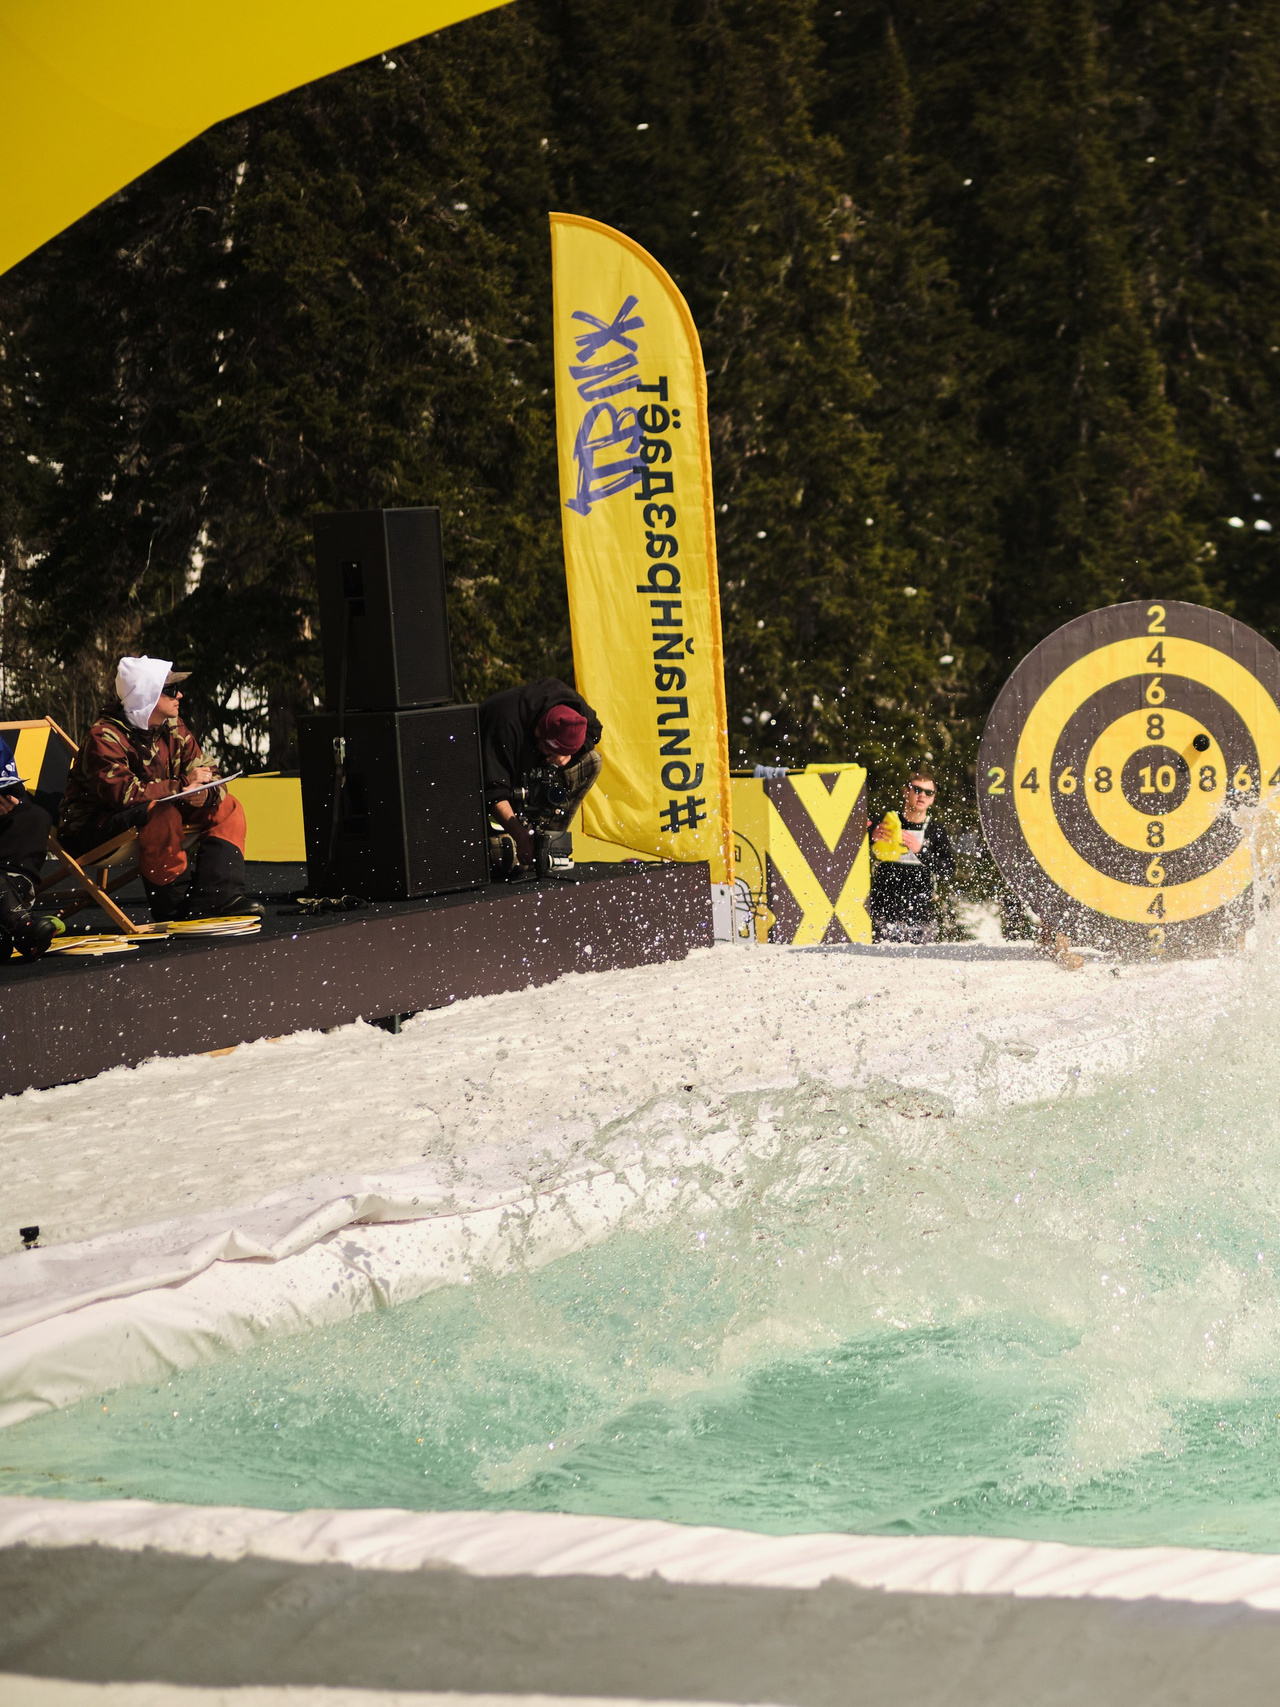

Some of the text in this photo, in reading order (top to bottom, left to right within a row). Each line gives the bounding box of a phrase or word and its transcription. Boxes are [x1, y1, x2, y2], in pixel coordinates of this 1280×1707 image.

[1147, 604, 1166, 633] 2
[1147, 641, 1166, 668] 4
[1146, 677, 1166, 705] 6
[1146, 713, 1165, 740] 8
[987, 767, 1006, 795] 2
[1020, 766, 1040, 794] 4
[1057, 766, 1077, 794] 6
[1094, 766, 1113, 793] 8
[1138, 765, 1177, 794] 10
[1198, 764, 1217, 792] 8
[1233, 764, 1253, 792] 6
[1146, 820, 1165, 848] 8
[1146, 857, 1166, 885] 6
[1147, 892, 1166, 919] 4
